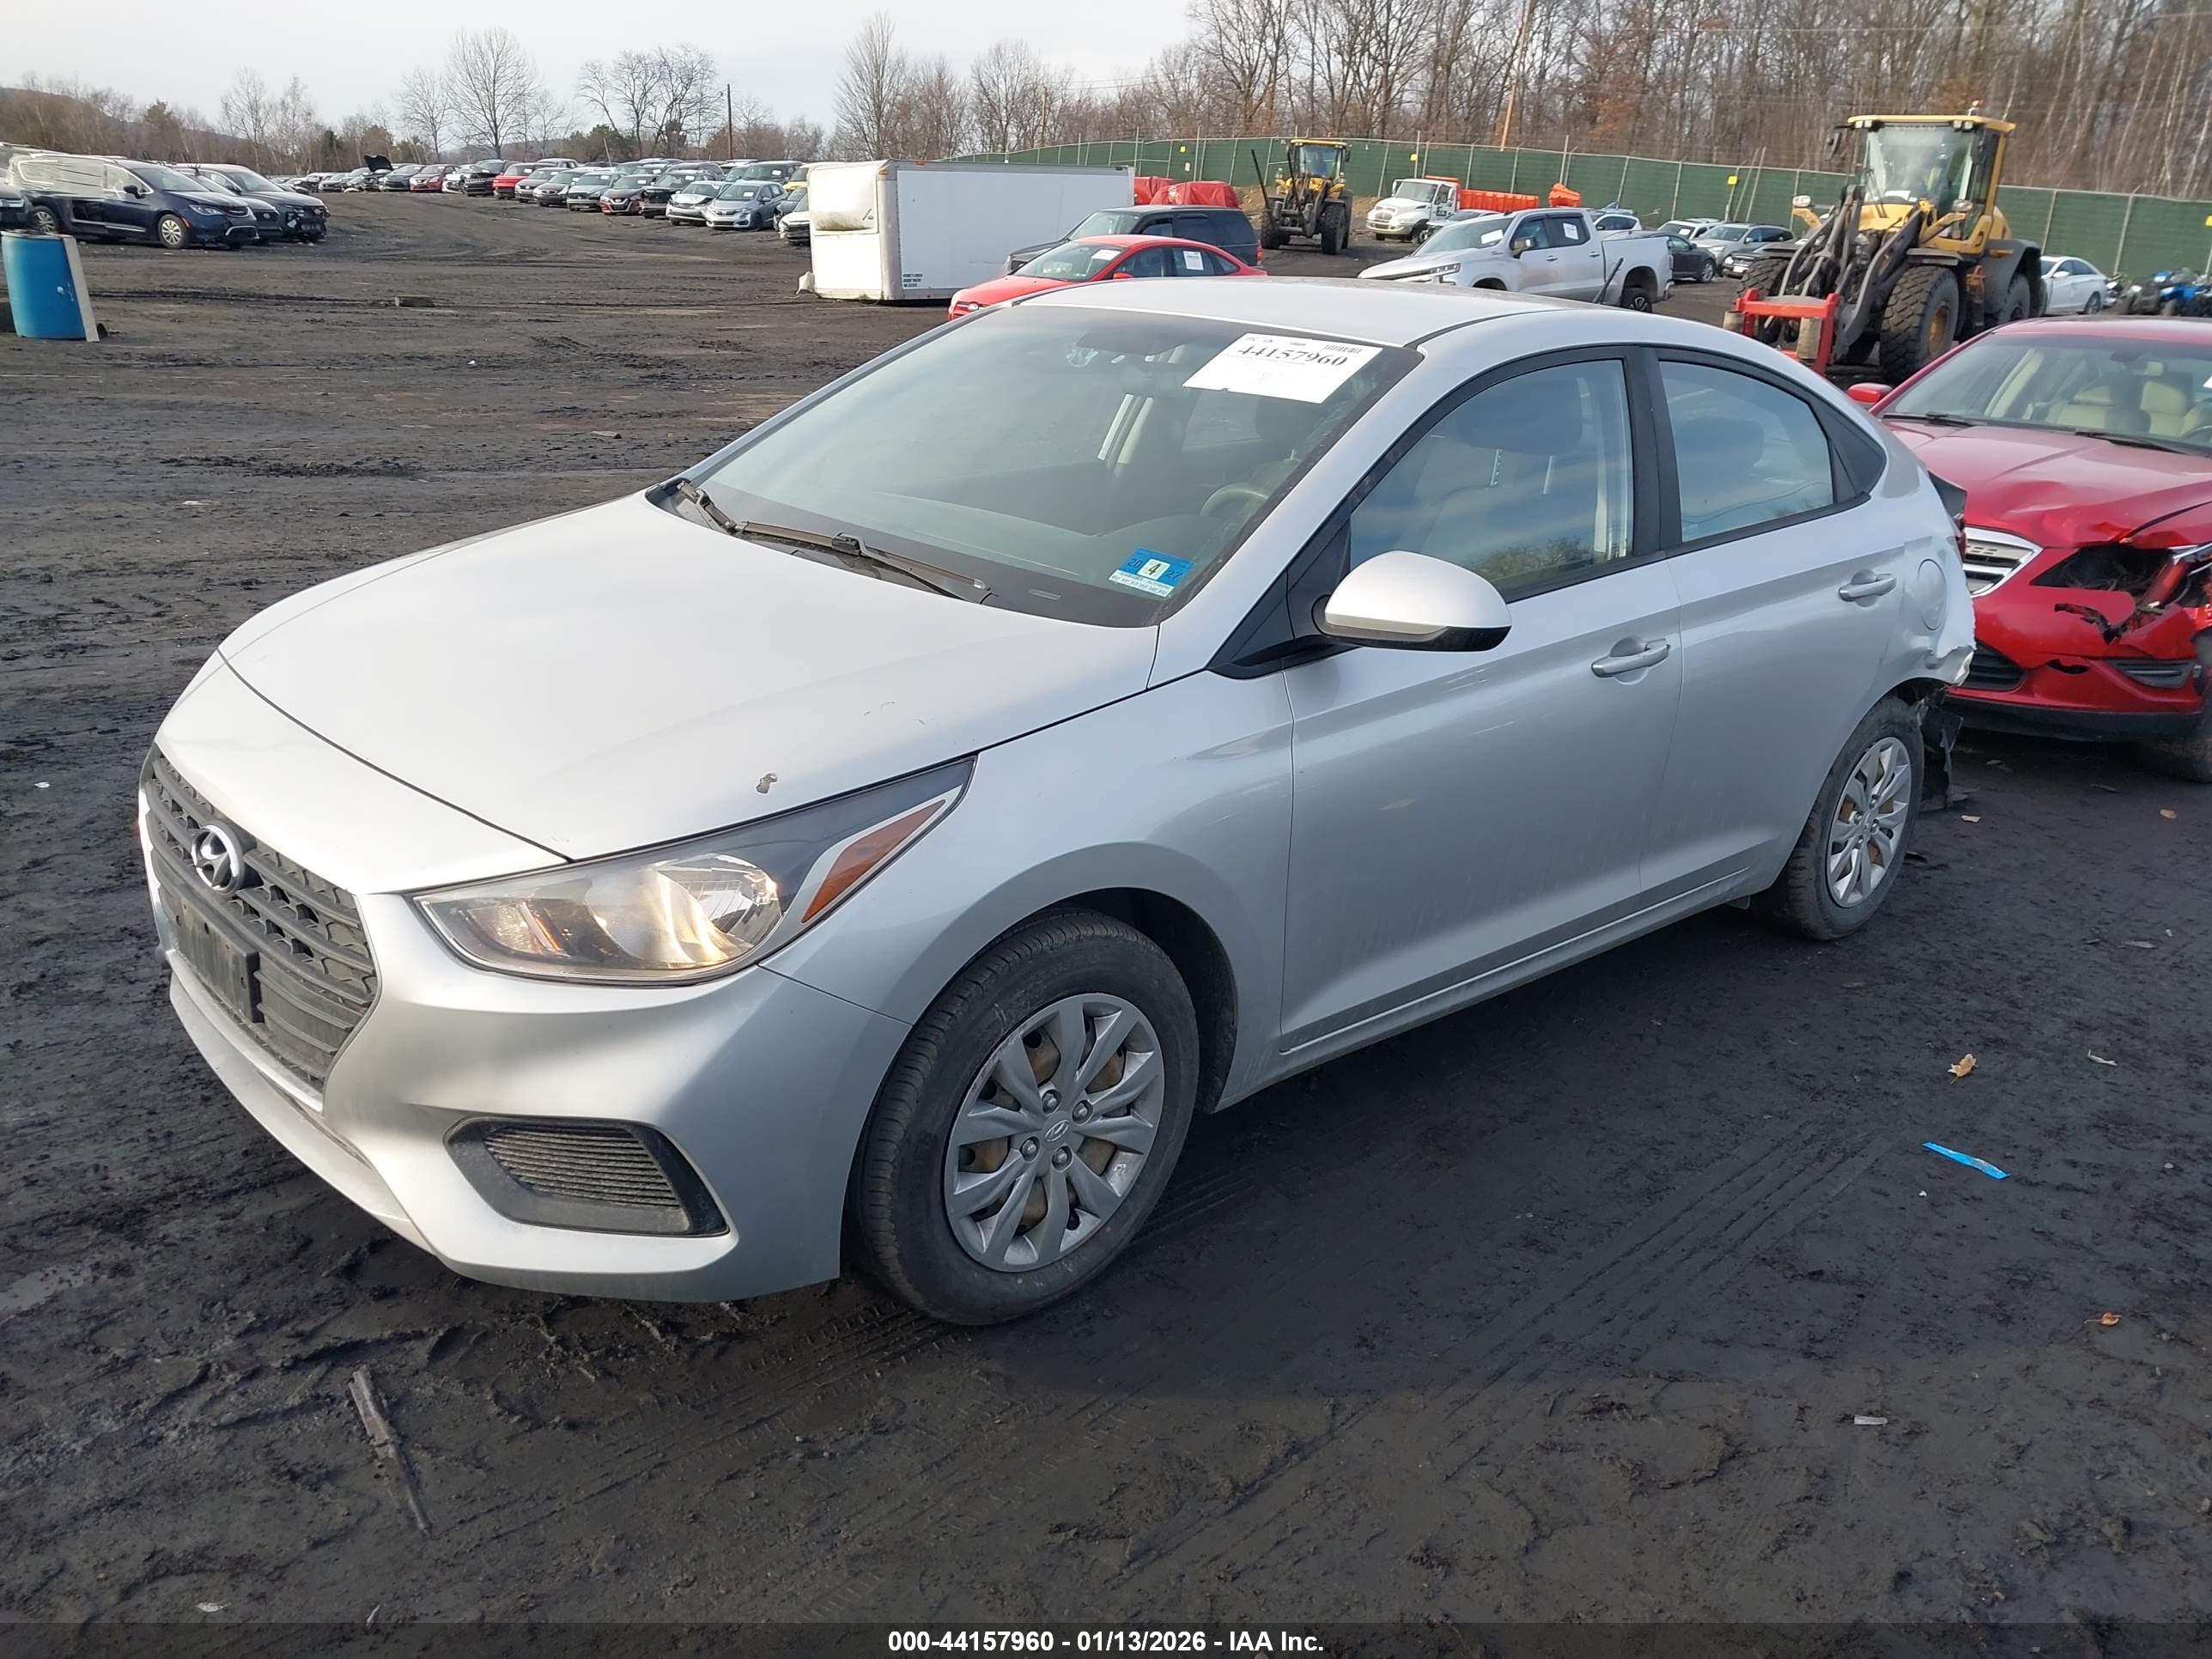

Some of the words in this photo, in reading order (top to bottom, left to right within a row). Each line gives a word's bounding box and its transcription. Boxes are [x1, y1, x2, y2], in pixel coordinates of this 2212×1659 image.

[1237, 344, 1348, 367] 44157960
[1127, 557, 1145, 568] 20
[1148, 562, 1162, 575] 4
[1164, 568, 1182, 580] 27
